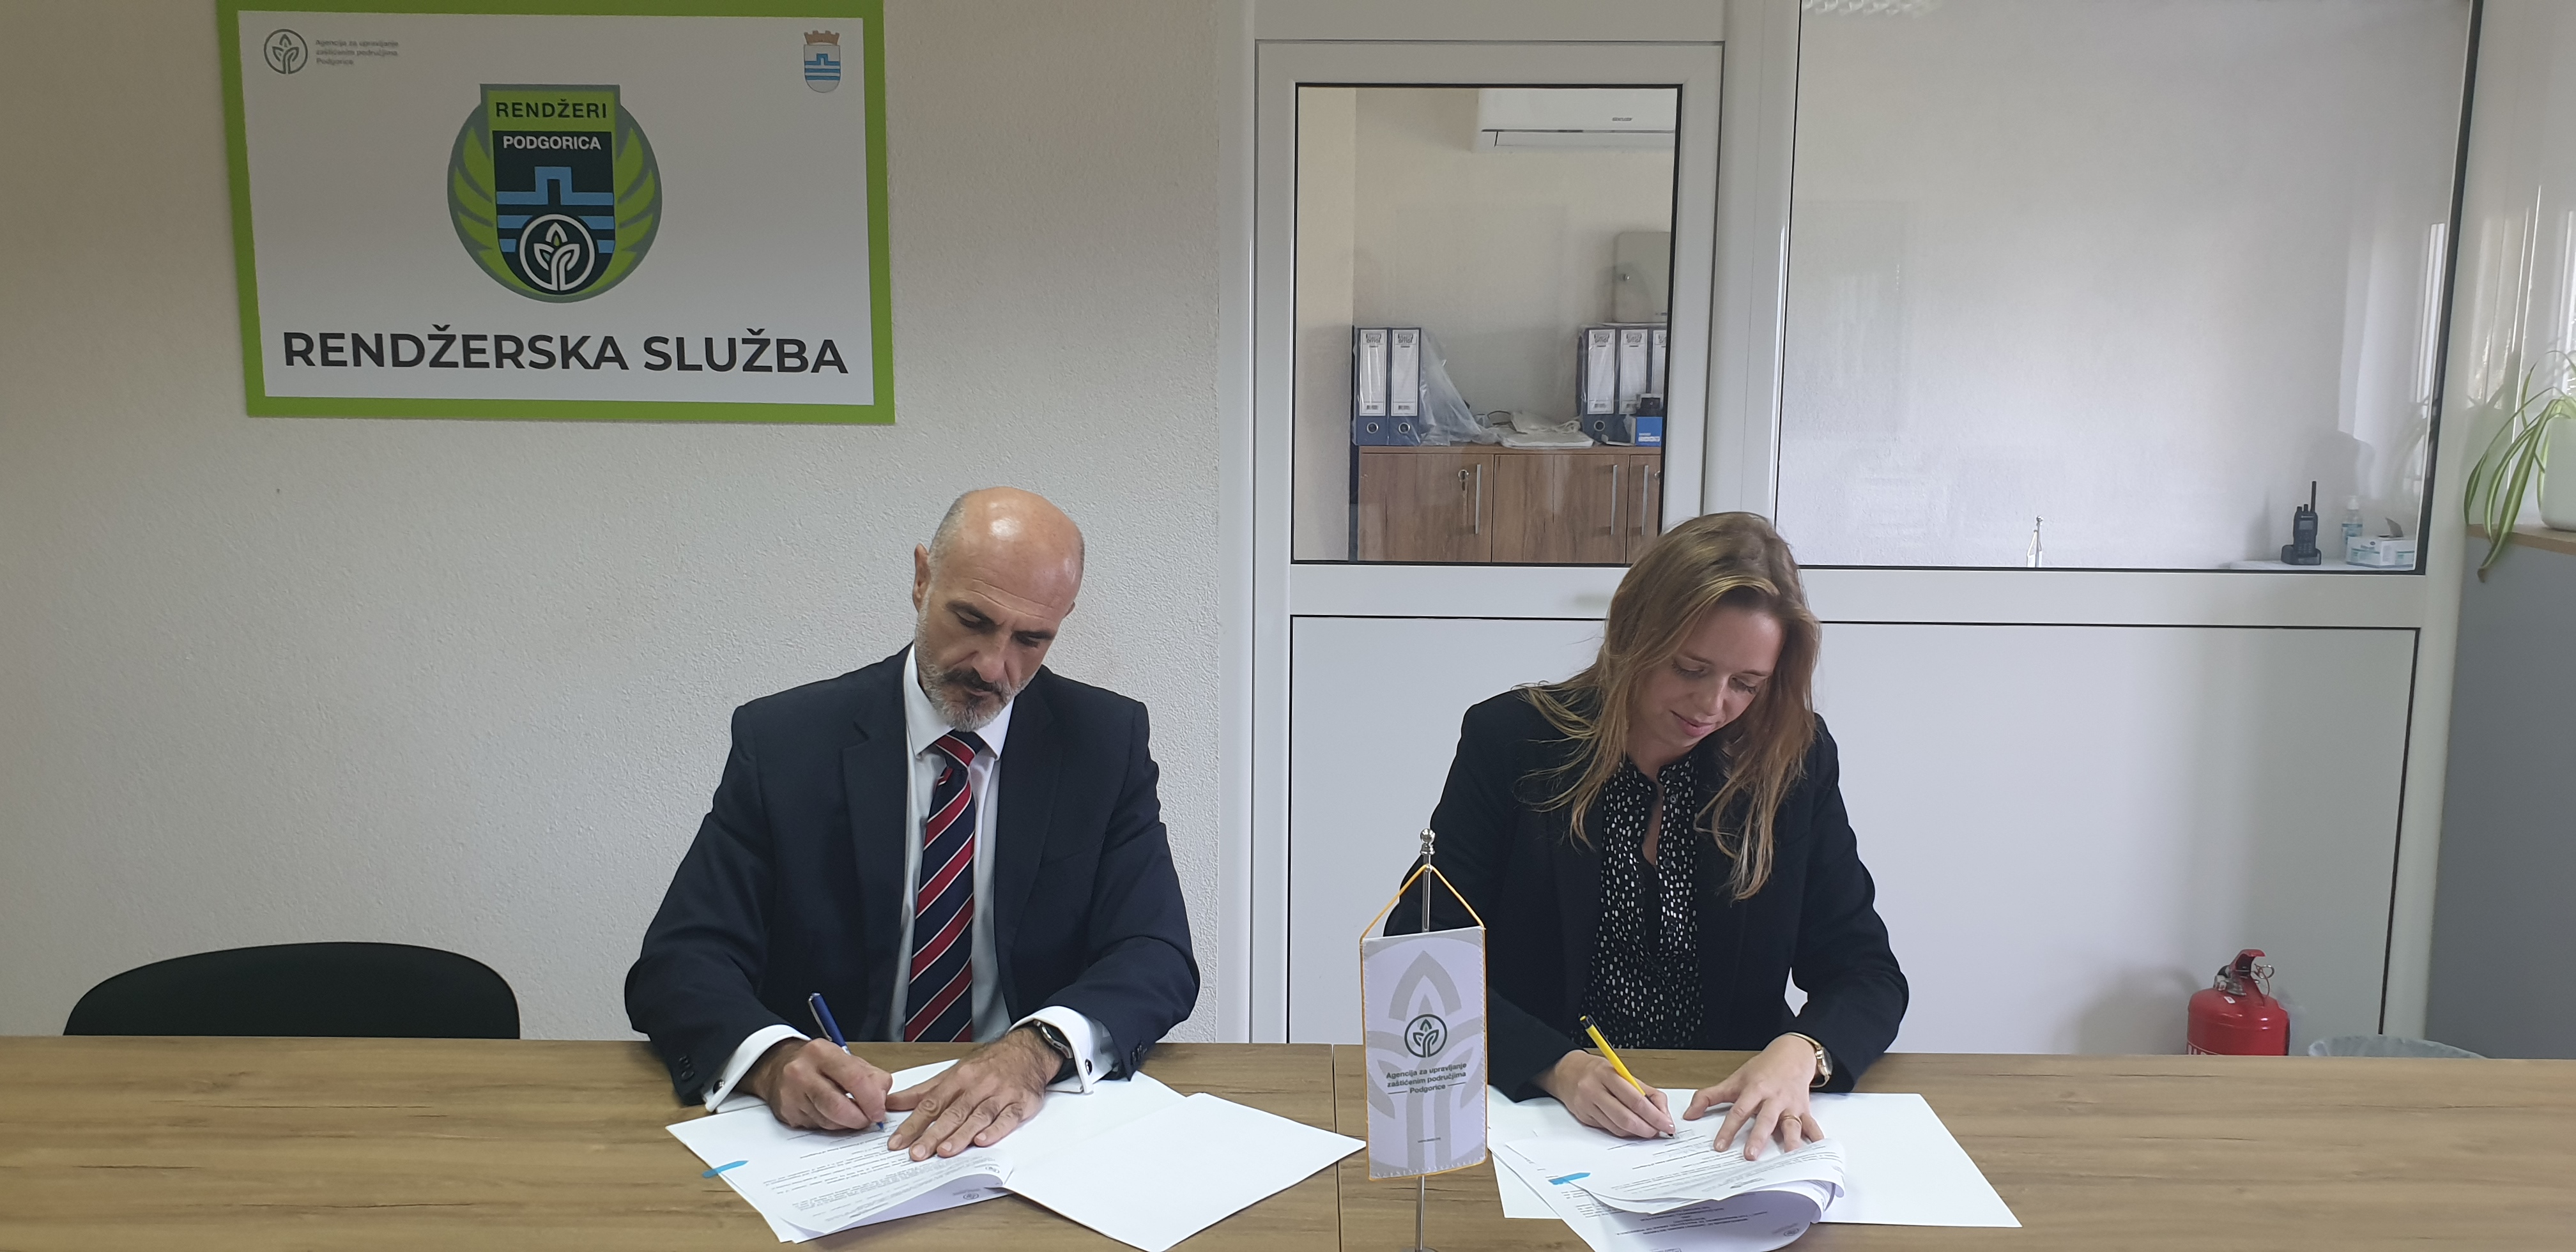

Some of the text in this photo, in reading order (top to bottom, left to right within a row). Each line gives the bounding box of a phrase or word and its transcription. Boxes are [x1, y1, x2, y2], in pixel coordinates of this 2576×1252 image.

[496, 98, 606, 119] RENDŽERI
[503, 135, 601, 150] PODGORICA
[284, 324, 848, 374] RENDŽERSKA SLUŽBA
[1386, 1070, 1418, 1079] Agencija
[1429, 1063, 1467, 1073] upravljanje
[1387, 1072, 1466, 1087] zaštićenim područjima
[1409, 1084, 1446, 1094] Podgorice
